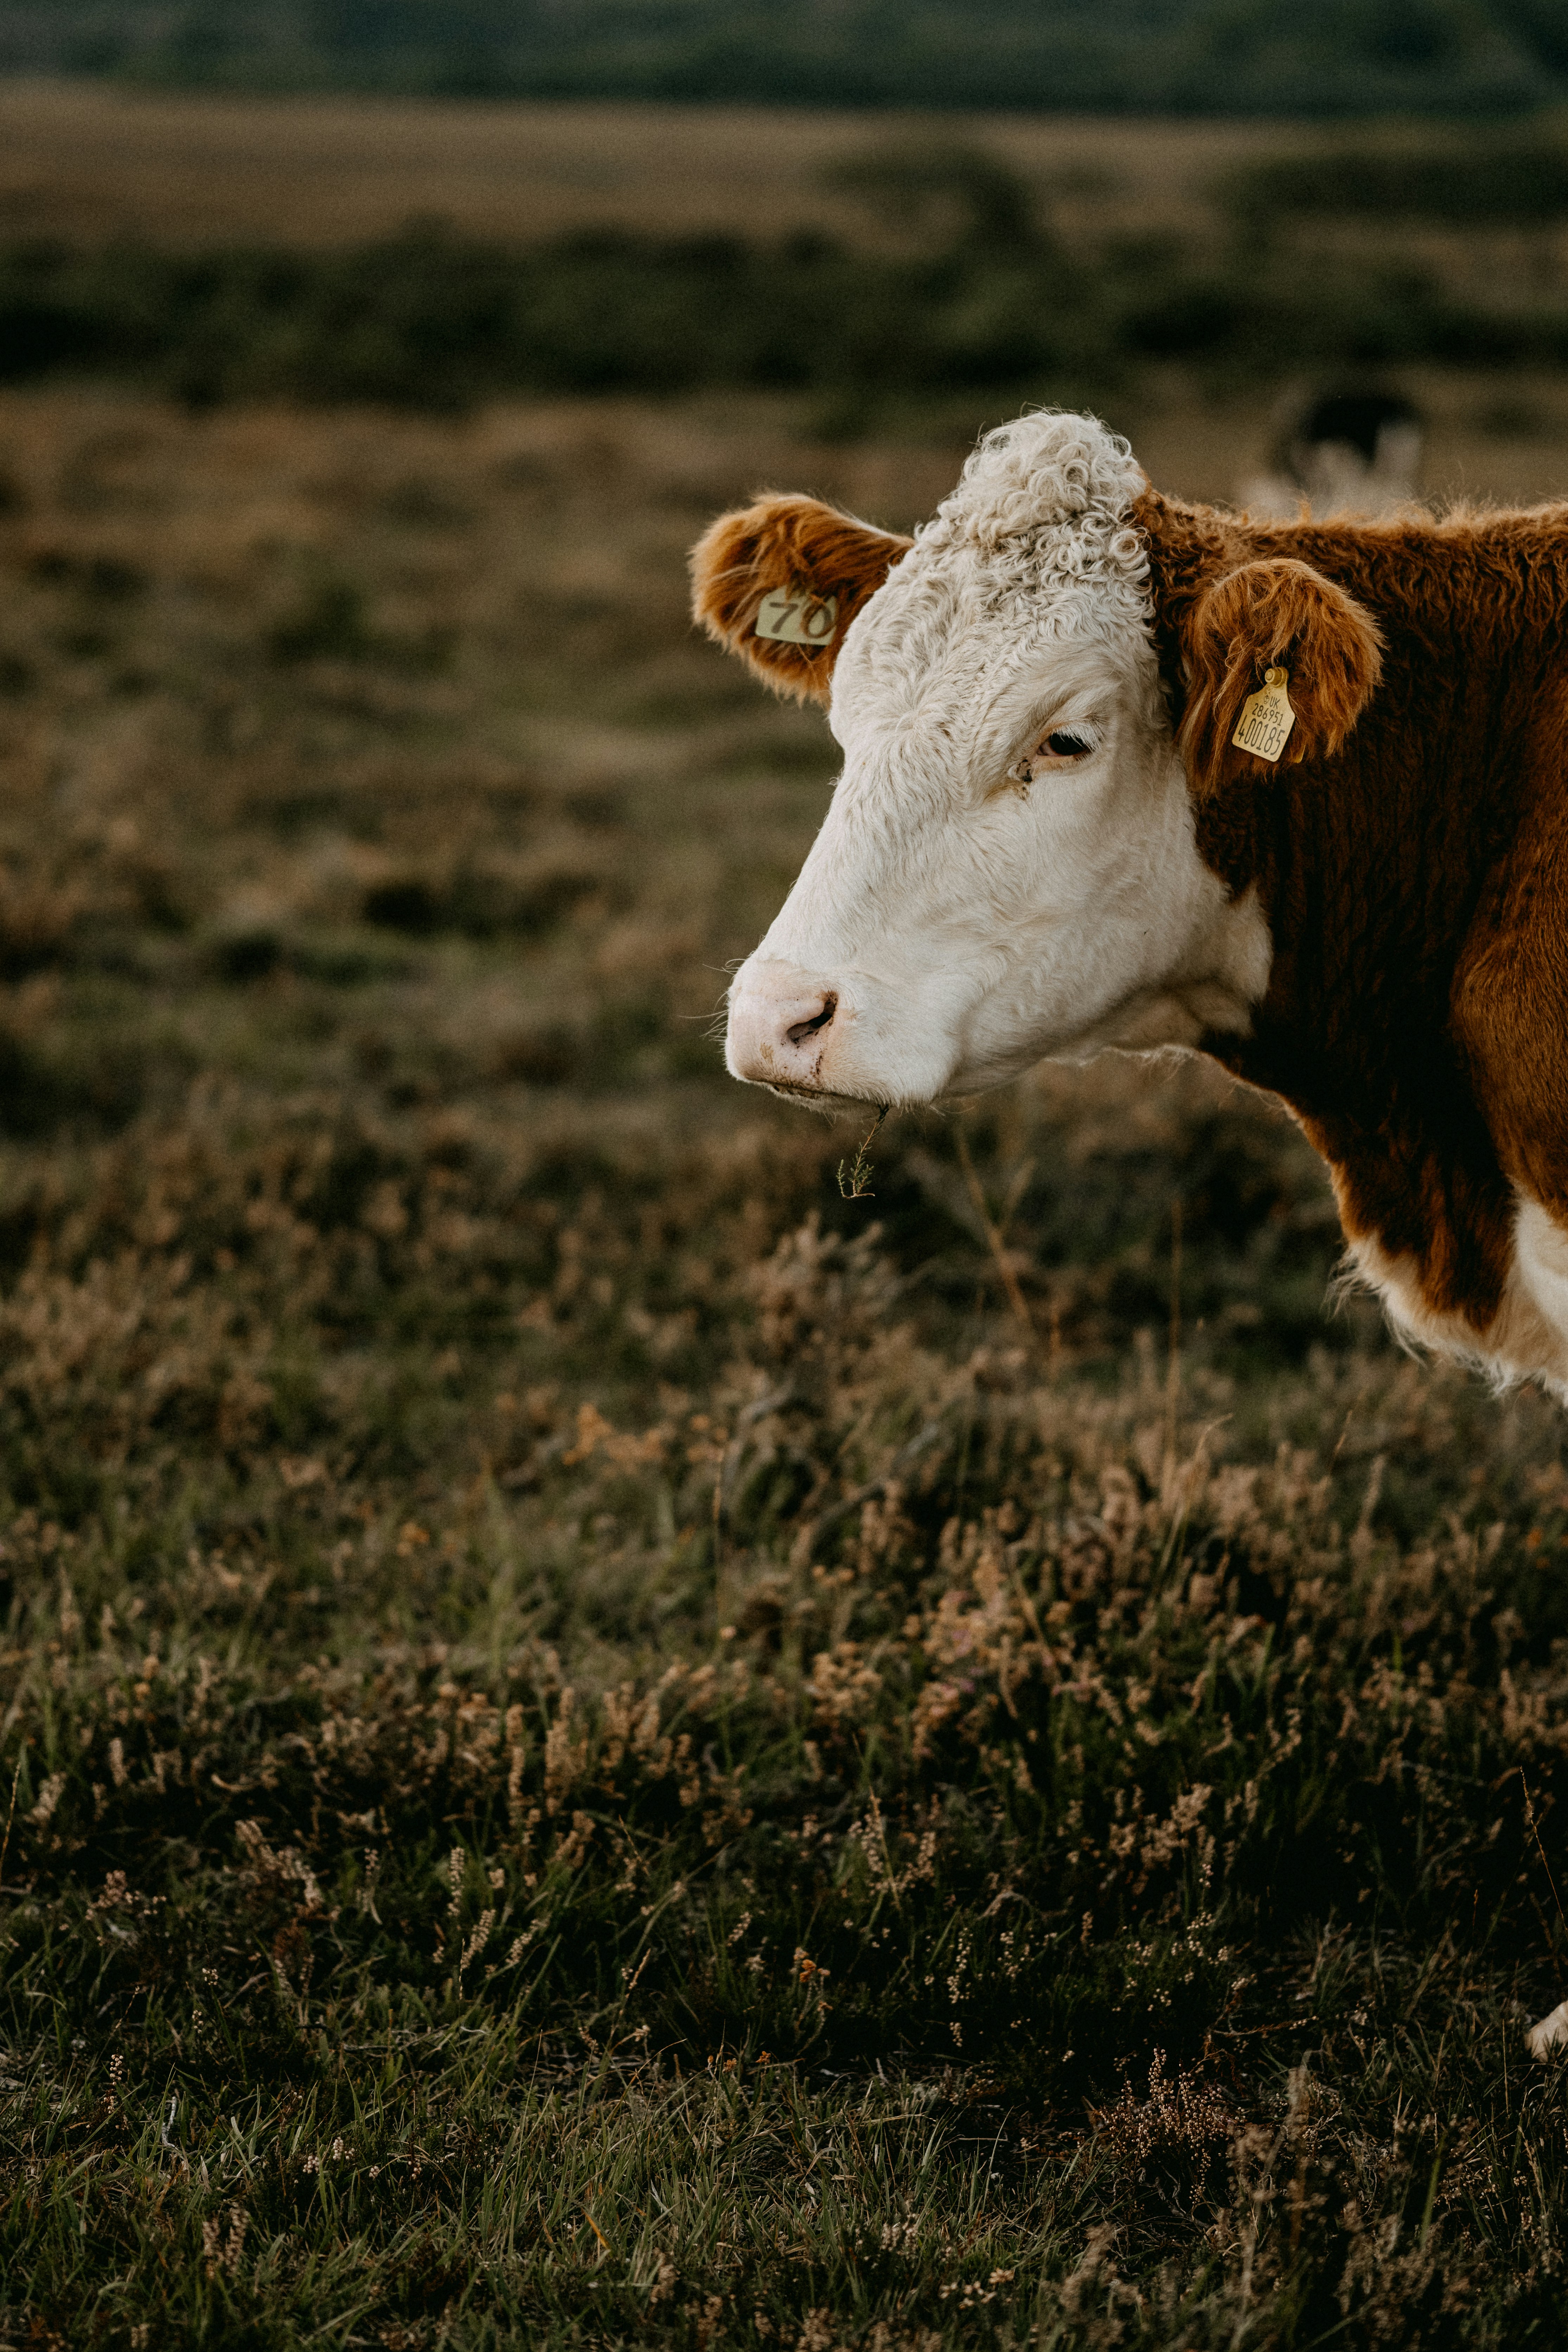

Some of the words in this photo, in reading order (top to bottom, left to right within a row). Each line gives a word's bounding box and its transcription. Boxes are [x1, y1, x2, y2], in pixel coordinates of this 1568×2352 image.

[1269, 696, 1281, 709] UK
[1252, 703, 1284, 726] 286951
[1238, 714, 1285, 756] 400185
